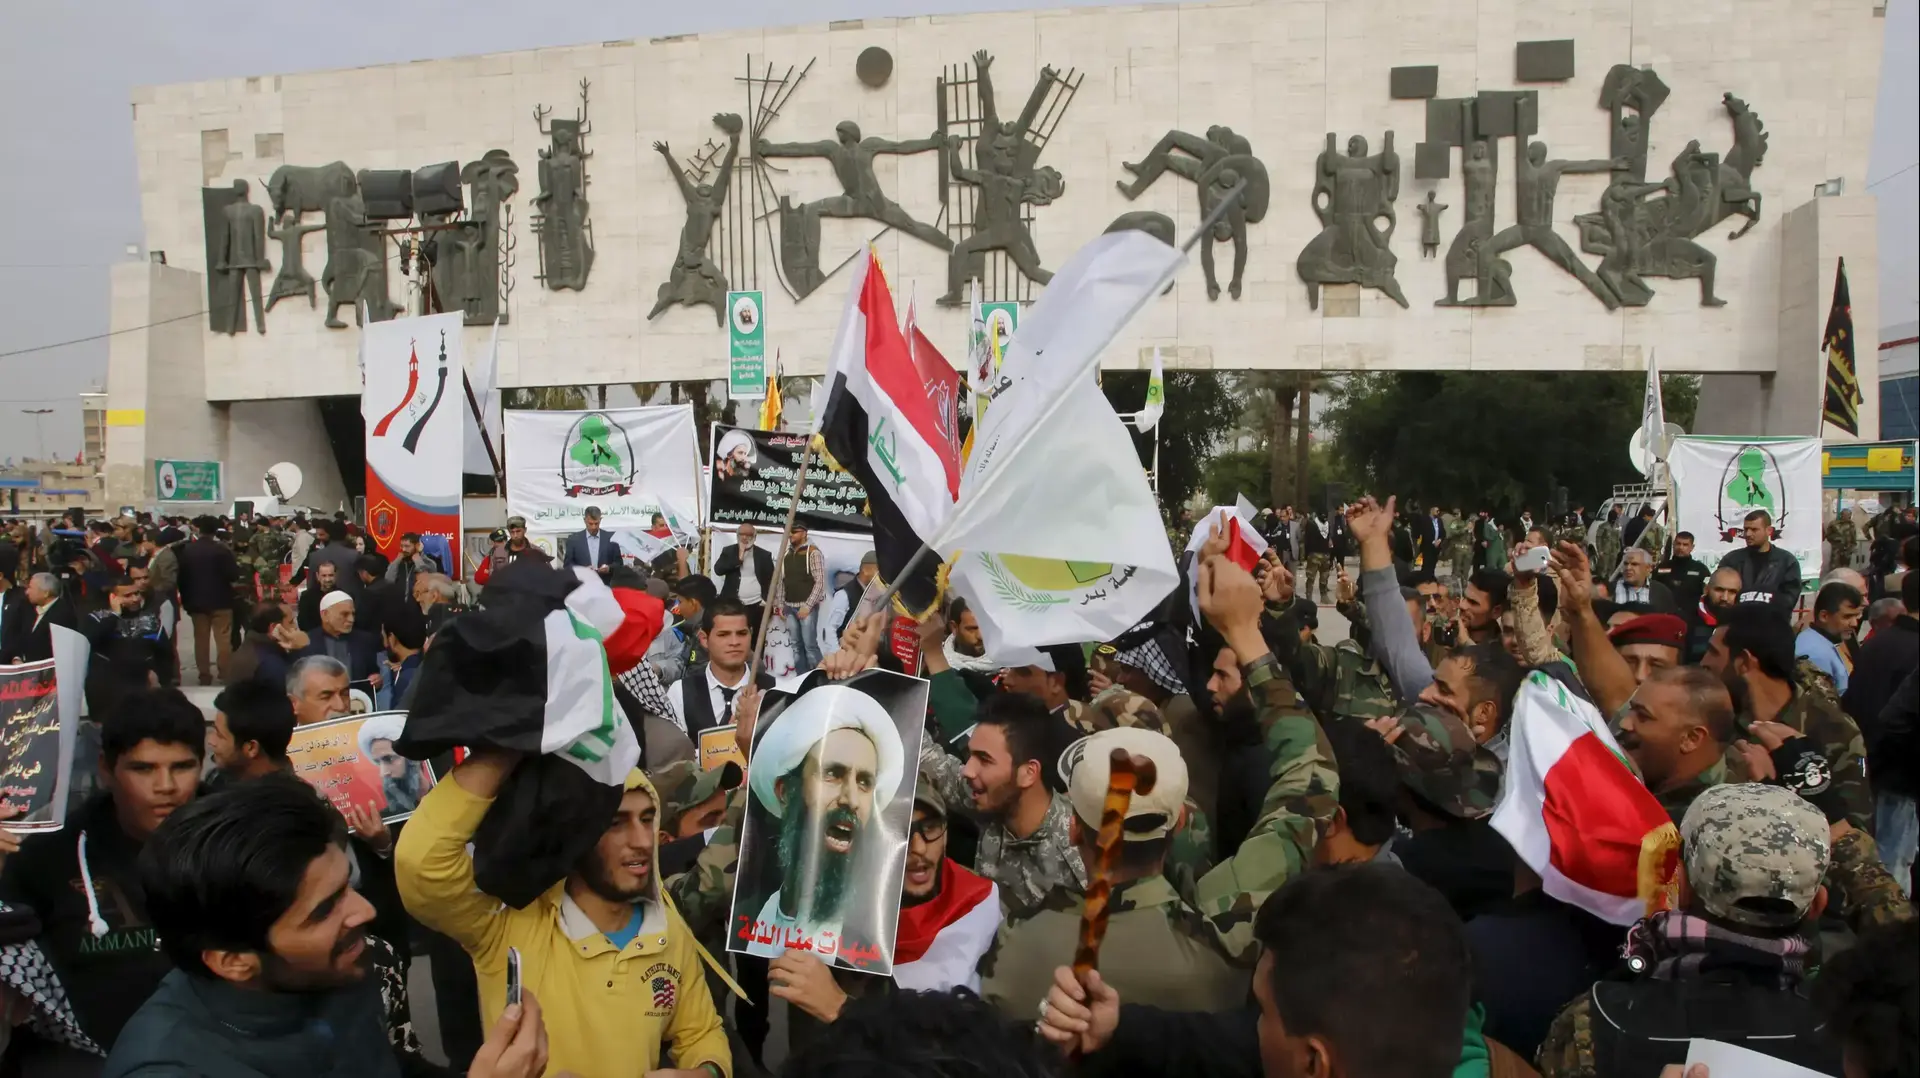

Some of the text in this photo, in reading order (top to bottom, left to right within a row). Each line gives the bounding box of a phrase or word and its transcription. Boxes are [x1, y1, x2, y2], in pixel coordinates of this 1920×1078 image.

[1080, 588, 1107, 605] بدر
[1740, 591, 1773, 603] SWAT
[23, 761, 42, 780] في
[79, 928, 155, 953] ARMANI
[737, 914, 882, 967] هيهات منا الذلة
